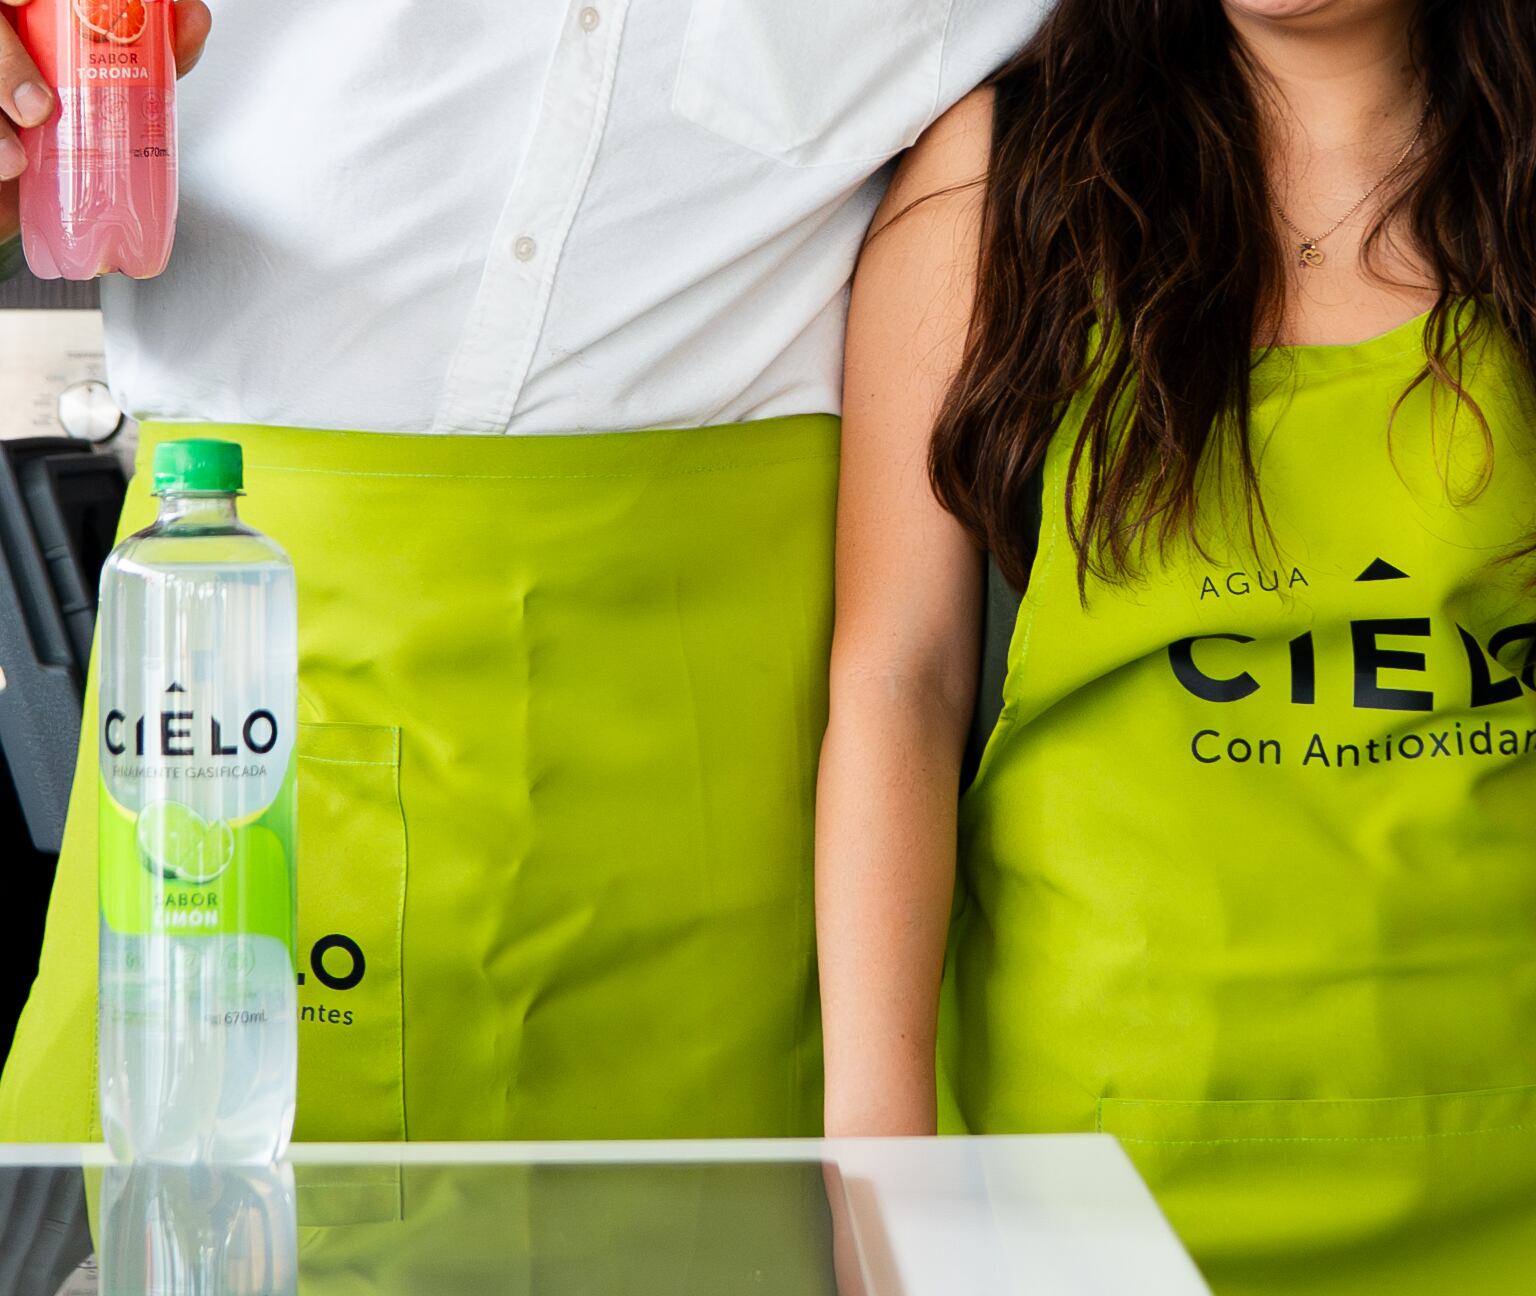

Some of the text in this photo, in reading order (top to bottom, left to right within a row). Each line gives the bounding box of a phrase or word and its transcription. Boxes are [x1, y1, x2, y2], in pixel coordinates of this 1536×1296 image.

[89, 52, 138, 65] SABOR
[77, 66, 149, 80] TORONJA
[1199, 567, 1309, 600] AGUA
[1191, 729, 1282, 765] Con
[184, 764, 268, 778] GASIFICADA
[224, 1008, 268, 1025] 670mL
